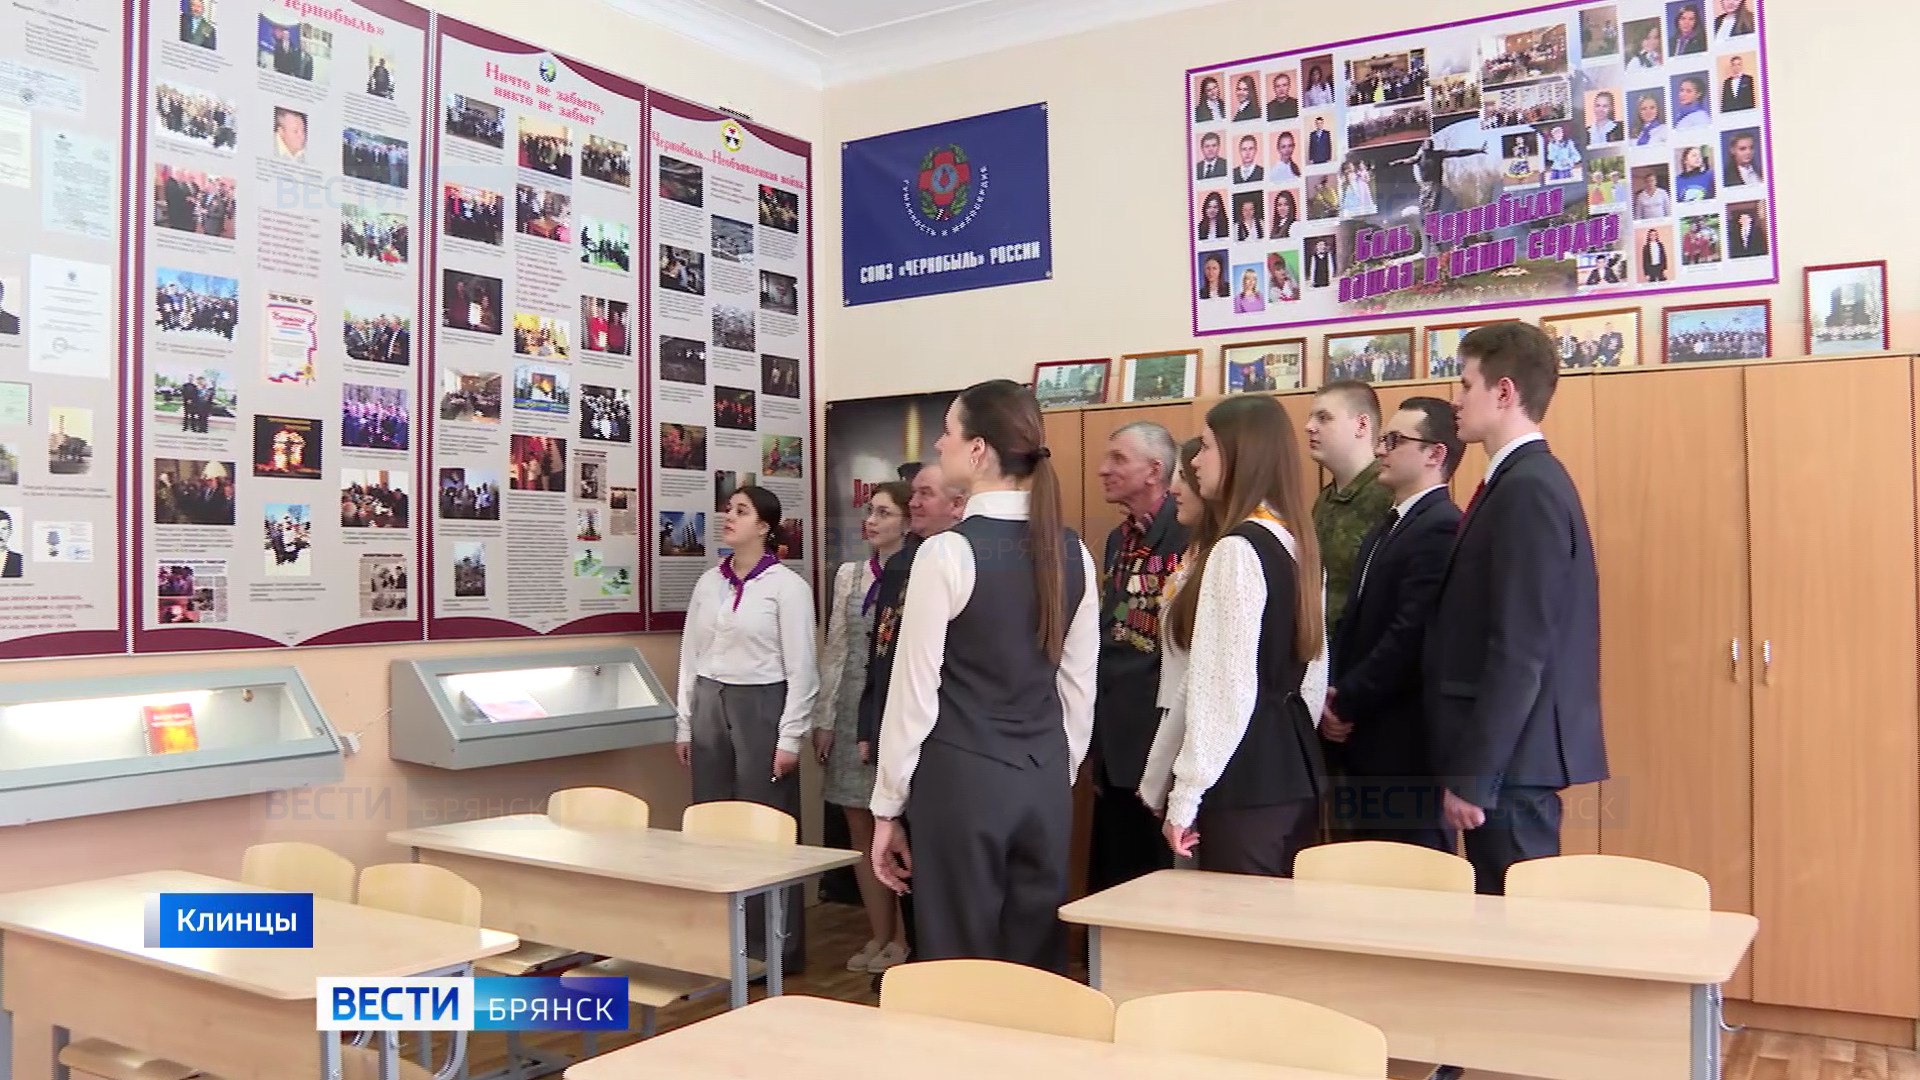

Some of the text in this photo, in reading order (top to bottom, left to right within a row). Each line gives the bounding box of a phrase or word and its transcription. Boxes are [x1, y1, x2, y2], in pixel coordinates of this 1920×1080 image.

[283, 0, 384, 35] ернобыль»
[485, 61, 531, 91] Ничто
[536, 84, 551, 96] не
[494, 86, 596, 125] никто не забыт
[902, 164, 989, 237] ГУМАННОСТЬ И МИЛОСЕРДИЕ
[1354, 224, 1416, 262] Боль
[1423, 187, 1564, 247] Чернобыля
[859, 241, 1041, 284] СОЮЗ «ЧЕРНОБЫЛЬ» РОССИИ
[1423, 255, 1440, 284] в
[1450, 236, 1518, 279] наши
[1526, 213, 1622, 261] сердца
